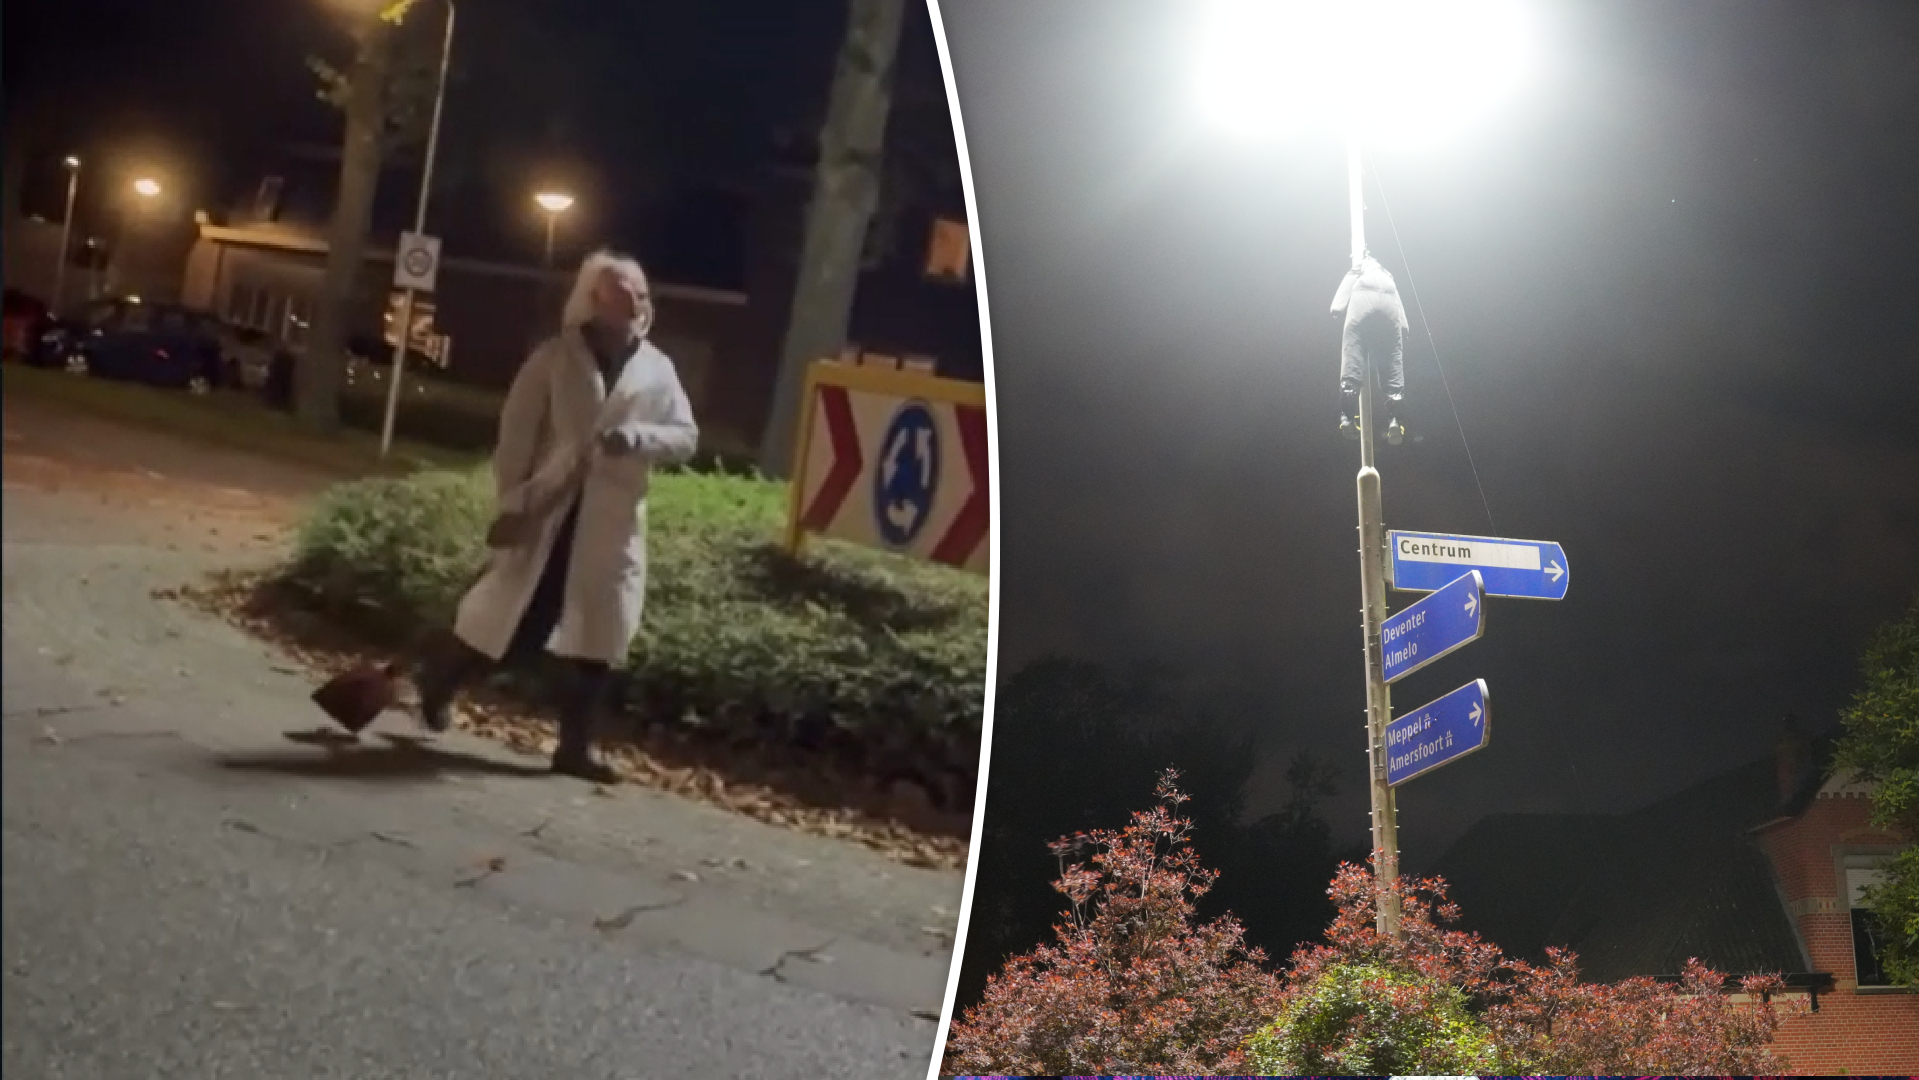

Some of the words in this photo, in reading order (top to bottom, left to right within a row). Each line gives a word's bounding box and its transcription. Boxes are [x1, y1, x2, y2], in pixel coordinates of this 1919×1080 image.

[1400, 540, 1471, 559] Centrum
[1384, 610, 1426, 645] Deventer
[1385, 642, 1418, 670] Almelo
[1388, 716, 1422, 747] Meppel
[1389, 735, 1443, 774] Amersfoort
